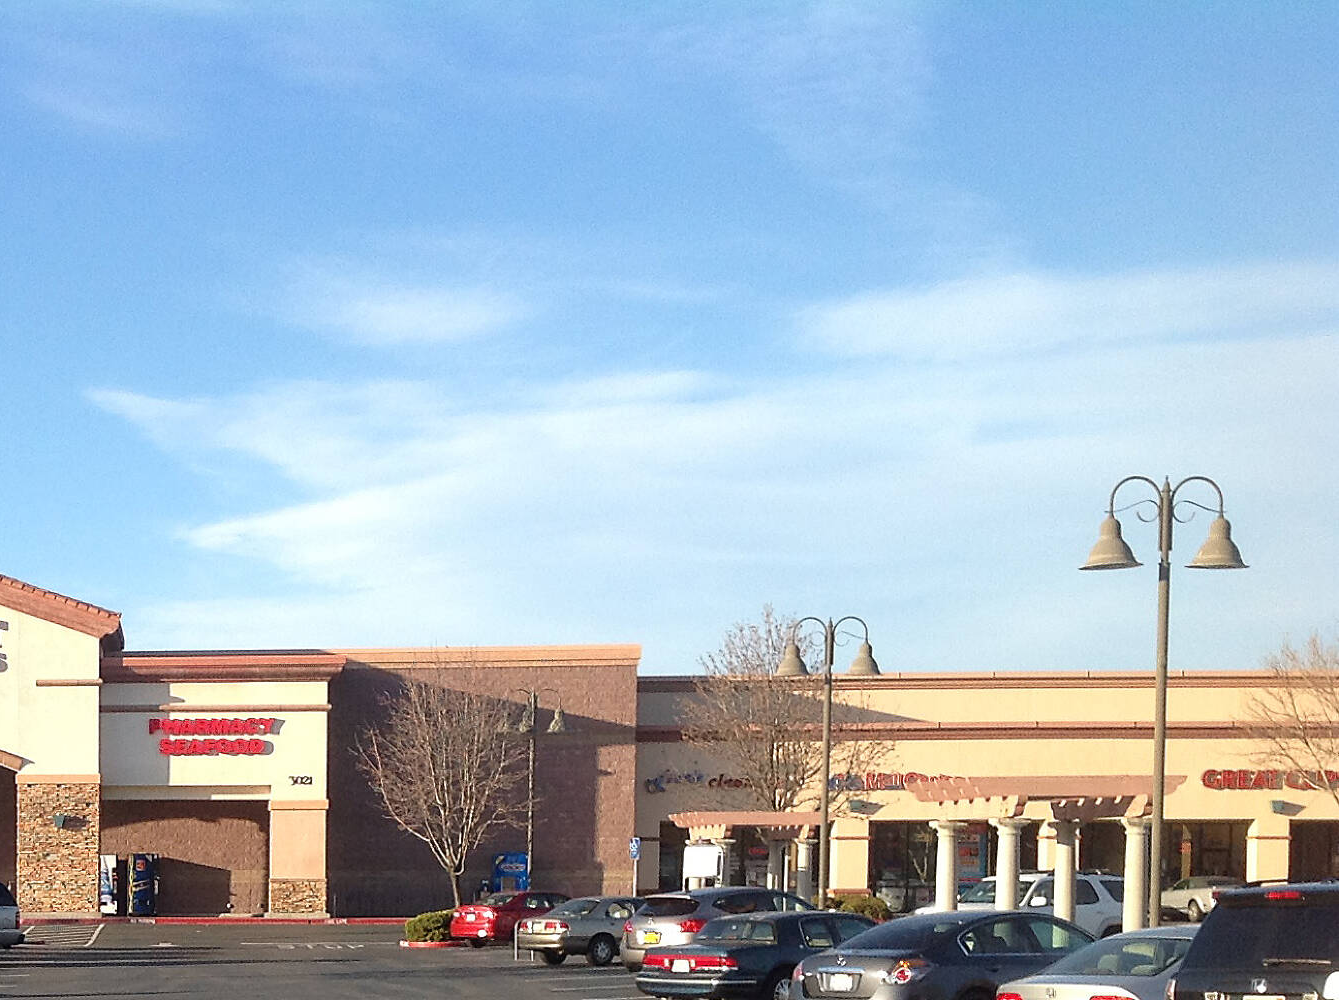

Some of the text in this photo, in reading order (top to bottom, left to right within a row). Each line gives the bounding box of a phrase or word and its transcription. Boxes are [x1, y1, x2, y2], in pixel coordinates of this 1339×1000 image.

[149, 718, 275, 735] PHARMACY
[160, 739, 265, 755] SEAFOOD
[1202, 769, 1279, 790] GREAT
